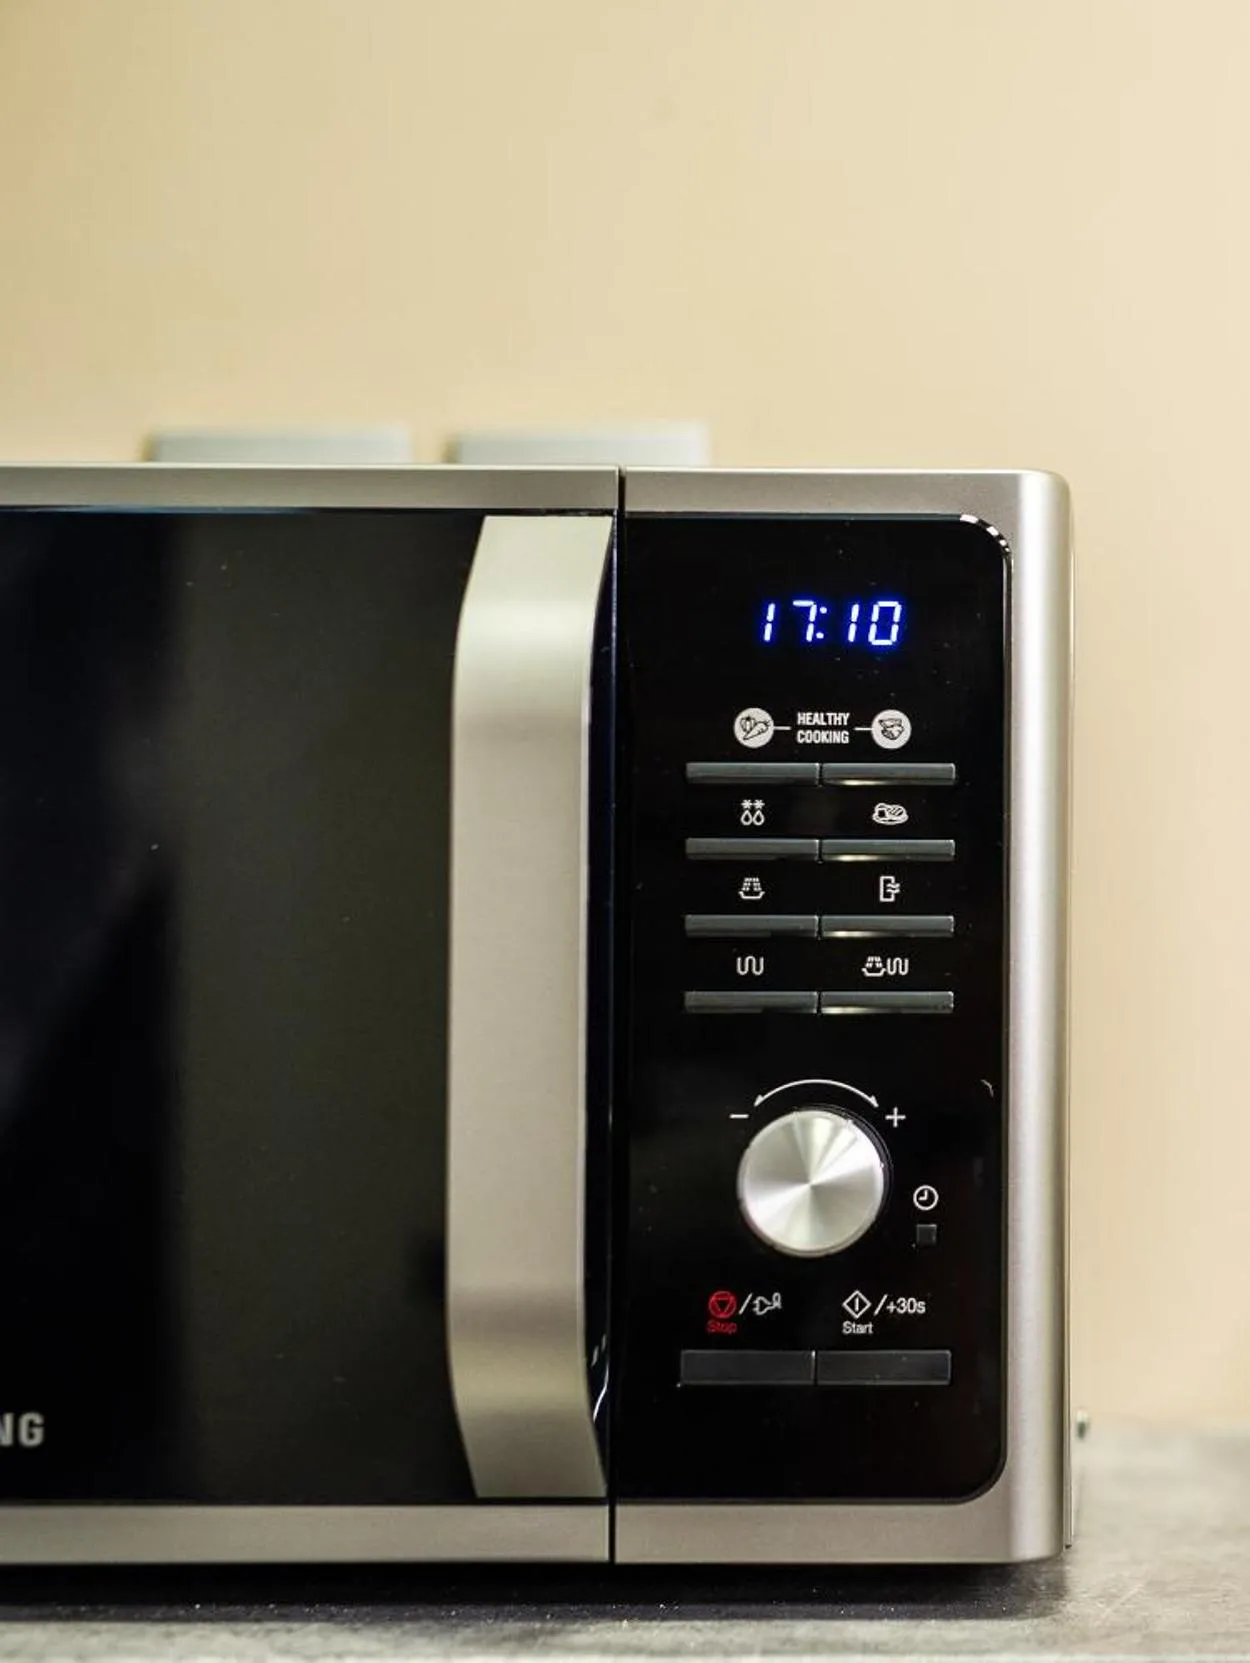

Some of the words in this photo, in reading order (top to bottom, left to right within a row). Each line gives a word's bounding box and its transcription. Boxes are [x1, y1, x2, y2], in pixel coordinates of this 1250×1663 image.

[764, 600, 903, 645] 17:10
[797, 712, 850, 726] HEALTHY
[797, 729, 850, 744] COOKING
[707, 1320, 737, 1334] Stop
[842, 1320, 873, 1334] Start
